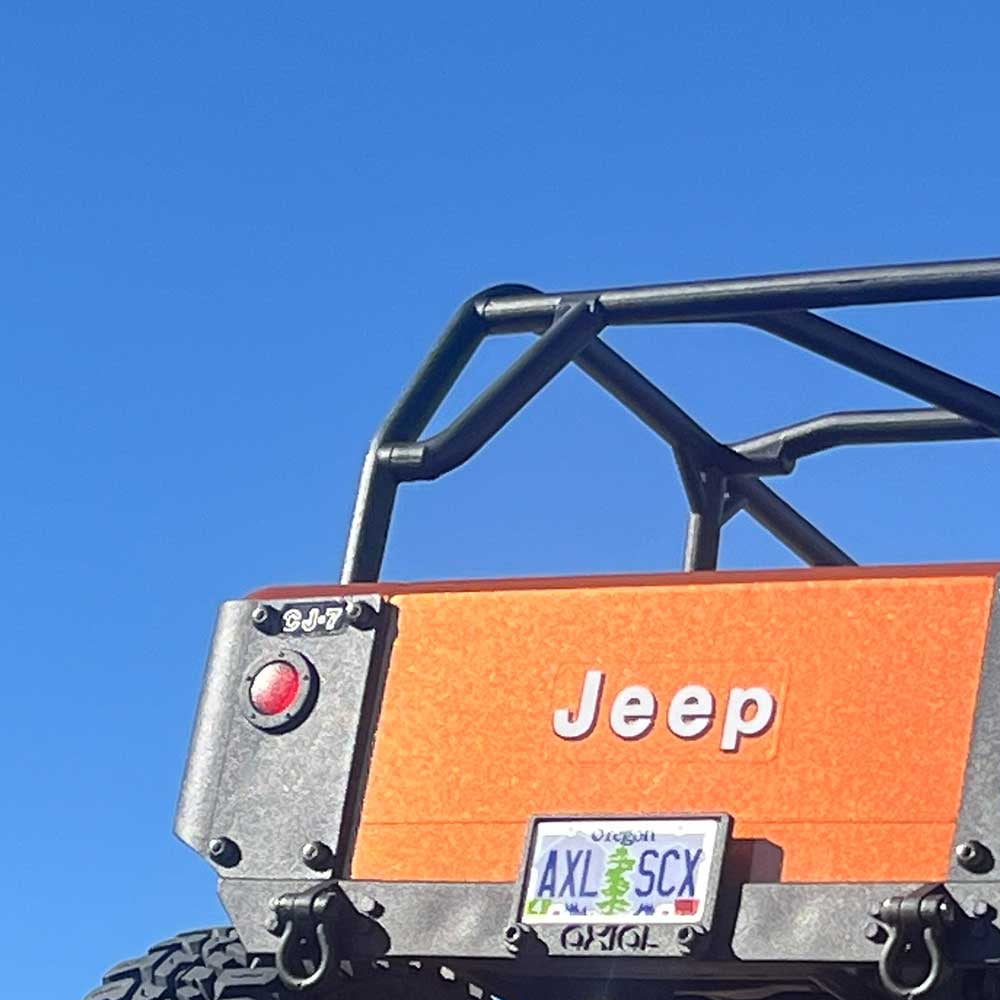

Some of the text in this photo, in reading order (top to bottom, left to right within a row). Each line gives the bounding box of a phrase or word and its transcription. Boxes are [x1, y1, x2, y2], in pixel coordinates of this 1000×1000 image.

[552, 670, 777, 753] Jeep
[591, 829, 656, 846] Oregon
[537, 849, 703, 897] AXL SCX
